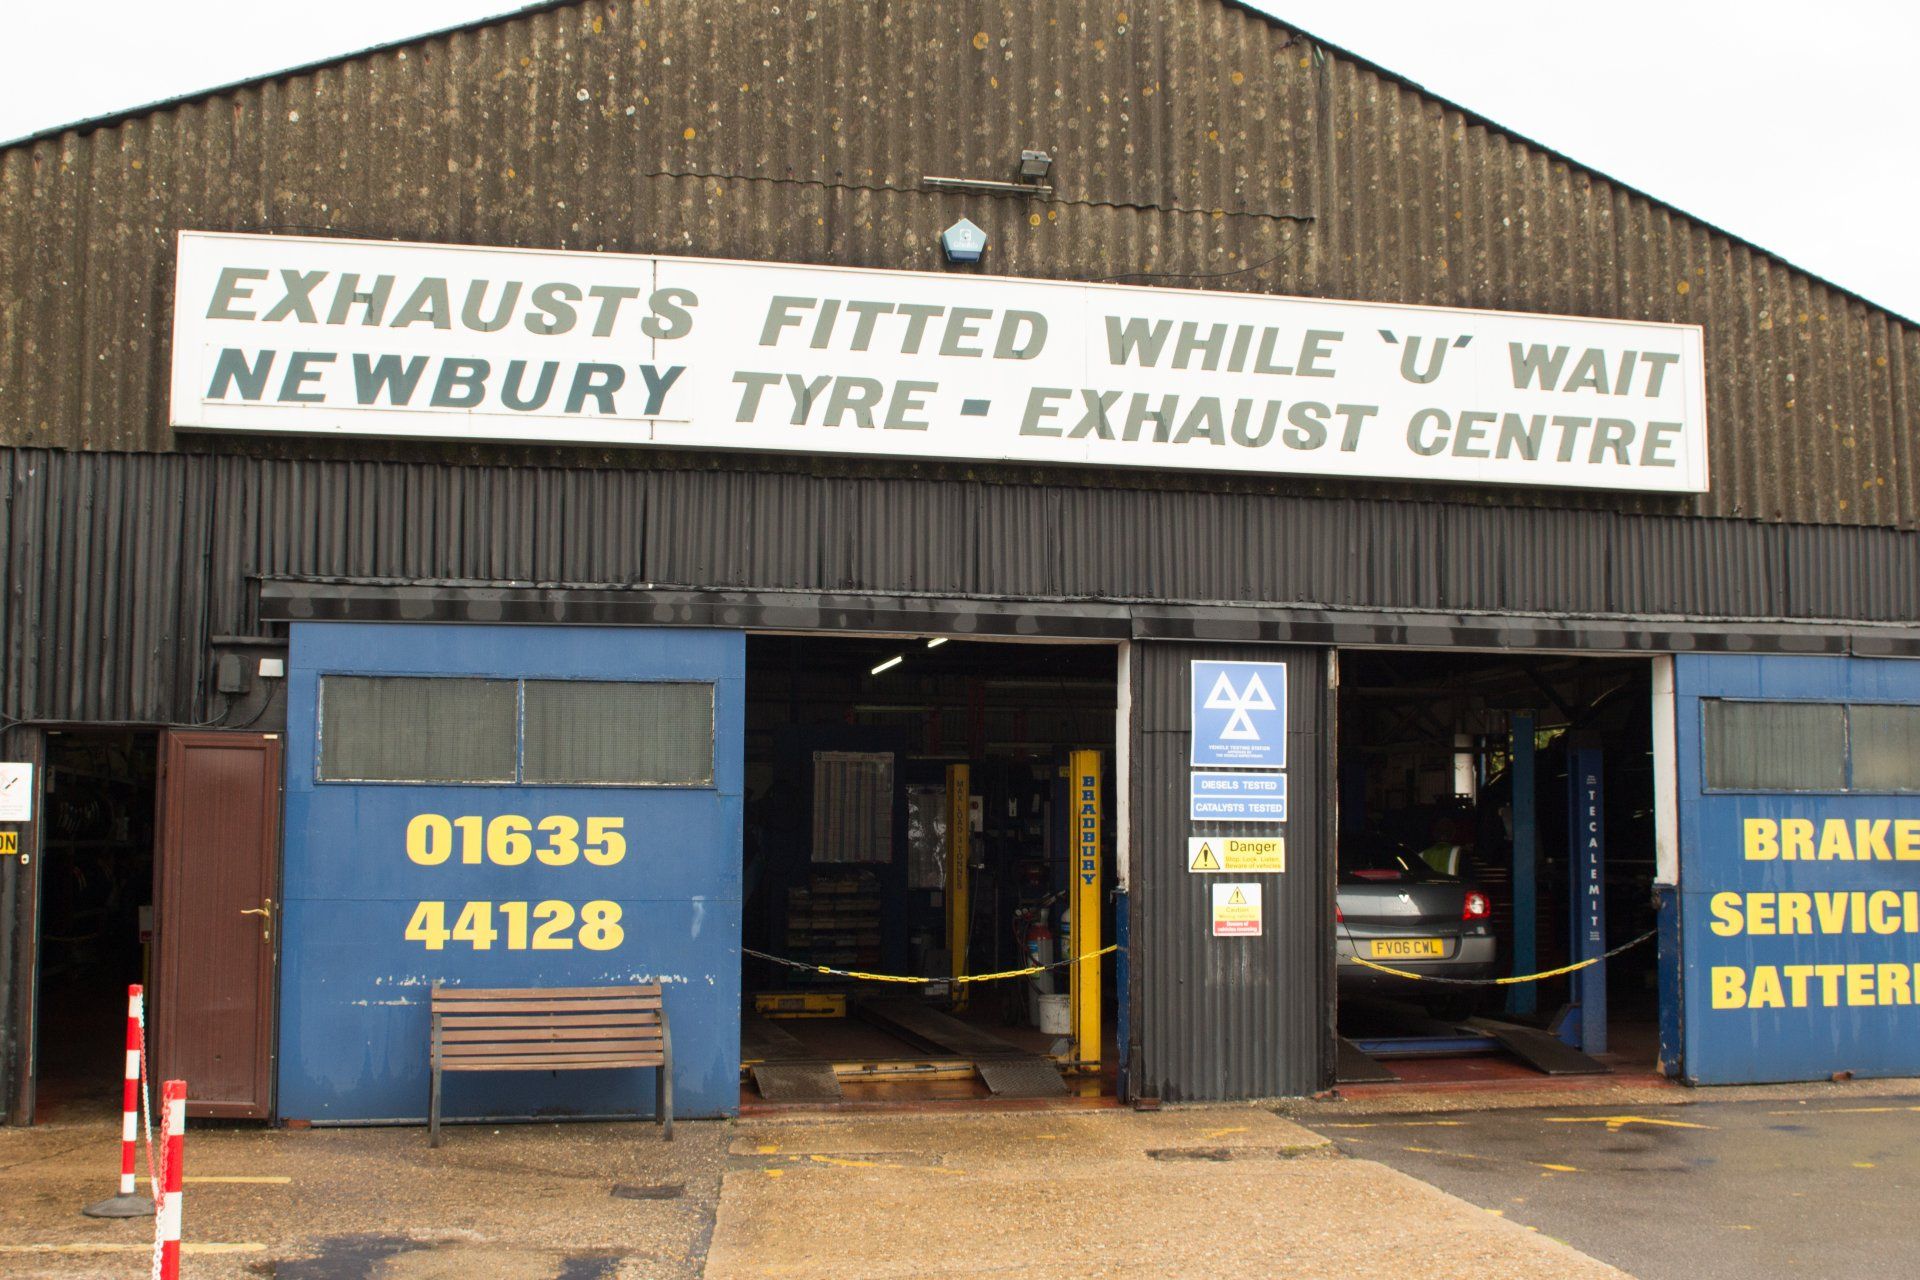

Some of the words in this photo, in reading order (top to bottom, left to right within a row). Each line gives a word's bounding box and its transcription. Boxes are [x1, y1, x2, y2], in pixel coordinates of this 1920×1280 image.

[205, 267, 698, 339] EXHAUSTS
[759, 295, 1048, 360] FITTED
[1104, 315, 1344, 378] WHILE
[1509, 342, 1680, 398] WAIT
[206, 348, 687, 416] NEWBURY
[732, 371, 939, 431] TYRE
[1019, 387, 1379, 452] EXHAUST
[1406, 408, 1683, 467] CENTRE
[1195, 802, 1245, 812] CATALYSTS
[1248, 803, 1283, 813] TESTED
[1201, 780, 1239, 790] DIESELS
[1242, 781, 1277, 791] TESTED
[406, 813, 627, 866] 01635
[1081, 776, 1097, 885] BRADBURY
[1230, 841, 1277, 855] Danger
[1743, 818, 1920, 861] BRAKE
[1588, 790, 1600, 926] TECALEMIT
[405, 900, 625, 951] 44128
[1710, 891, 1919, 937] SERVICI
[1376, 941, 1410, 954] FV06
[1413, 941, 1439, 954] CWL
